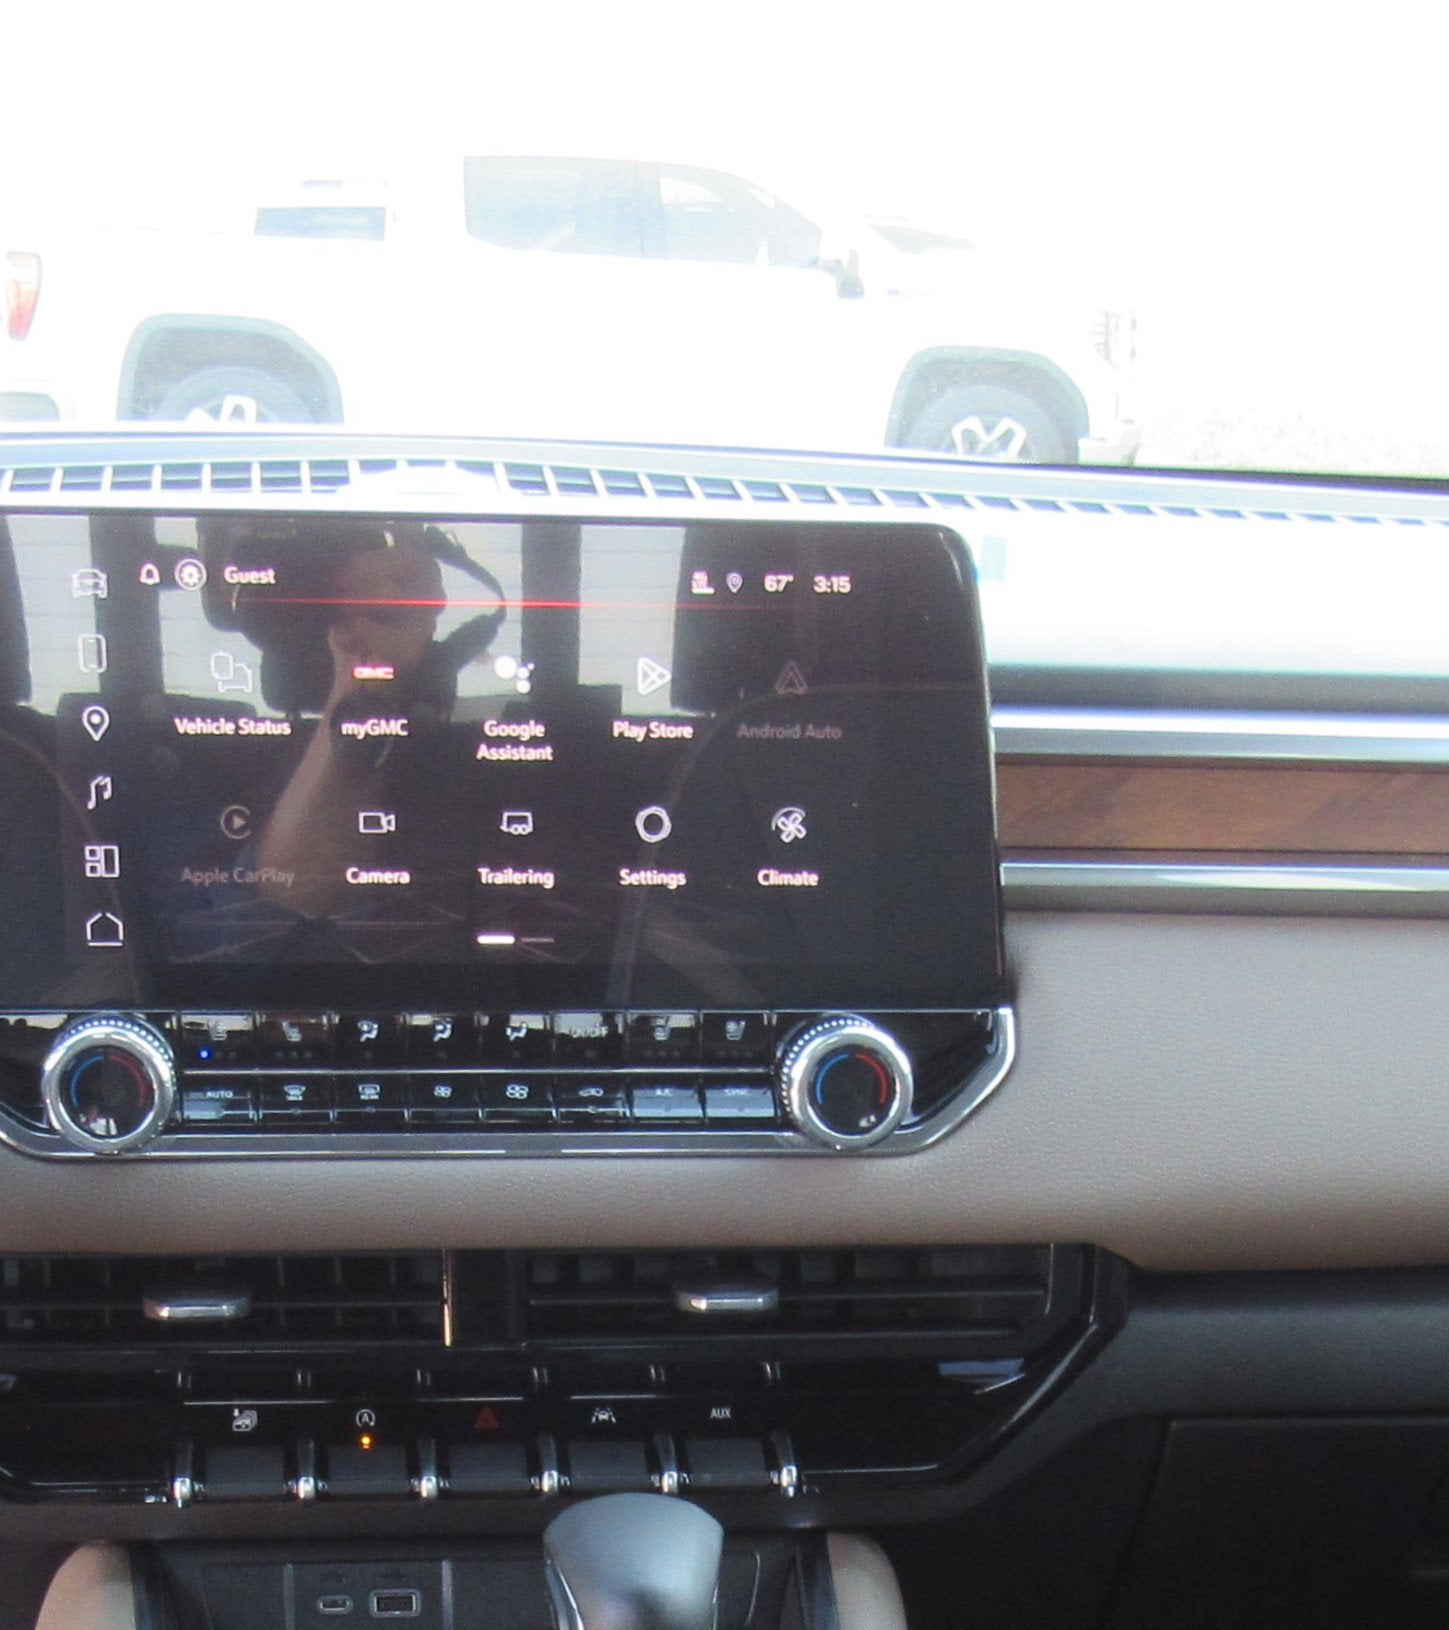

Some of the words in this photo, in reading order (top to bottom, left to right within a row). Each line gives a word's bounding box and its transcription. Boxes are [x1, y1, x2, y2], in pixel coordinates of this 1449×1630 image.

[223, 566, 276, 586] Guest
[812, 574, 852, 594] 3:15
[174, 717, 234, 736] Vehicle
[237, 718, 291, 737] Status
[340, 718, 409, 738] myGMC
[483, 720, 546, 741] Google
[612, 721, 647, 742] Play
[650, 722, 694, 740] Store
[736, 722, 800, 740] Android
[804, 724, 843, 741] Auto
[476, 744, 554, 762] Assistant
[180, 867, 228, 887] Apple
[231, 867, 295, 887] CarPlay
[345, 867, 411, 886] Camera
[478, 867, 555, 888] Trailering
[619, 867, 686, 889] Settings
[757, 868, 819, 887] Climate
[710, 1407, 732, 1419] AUX
